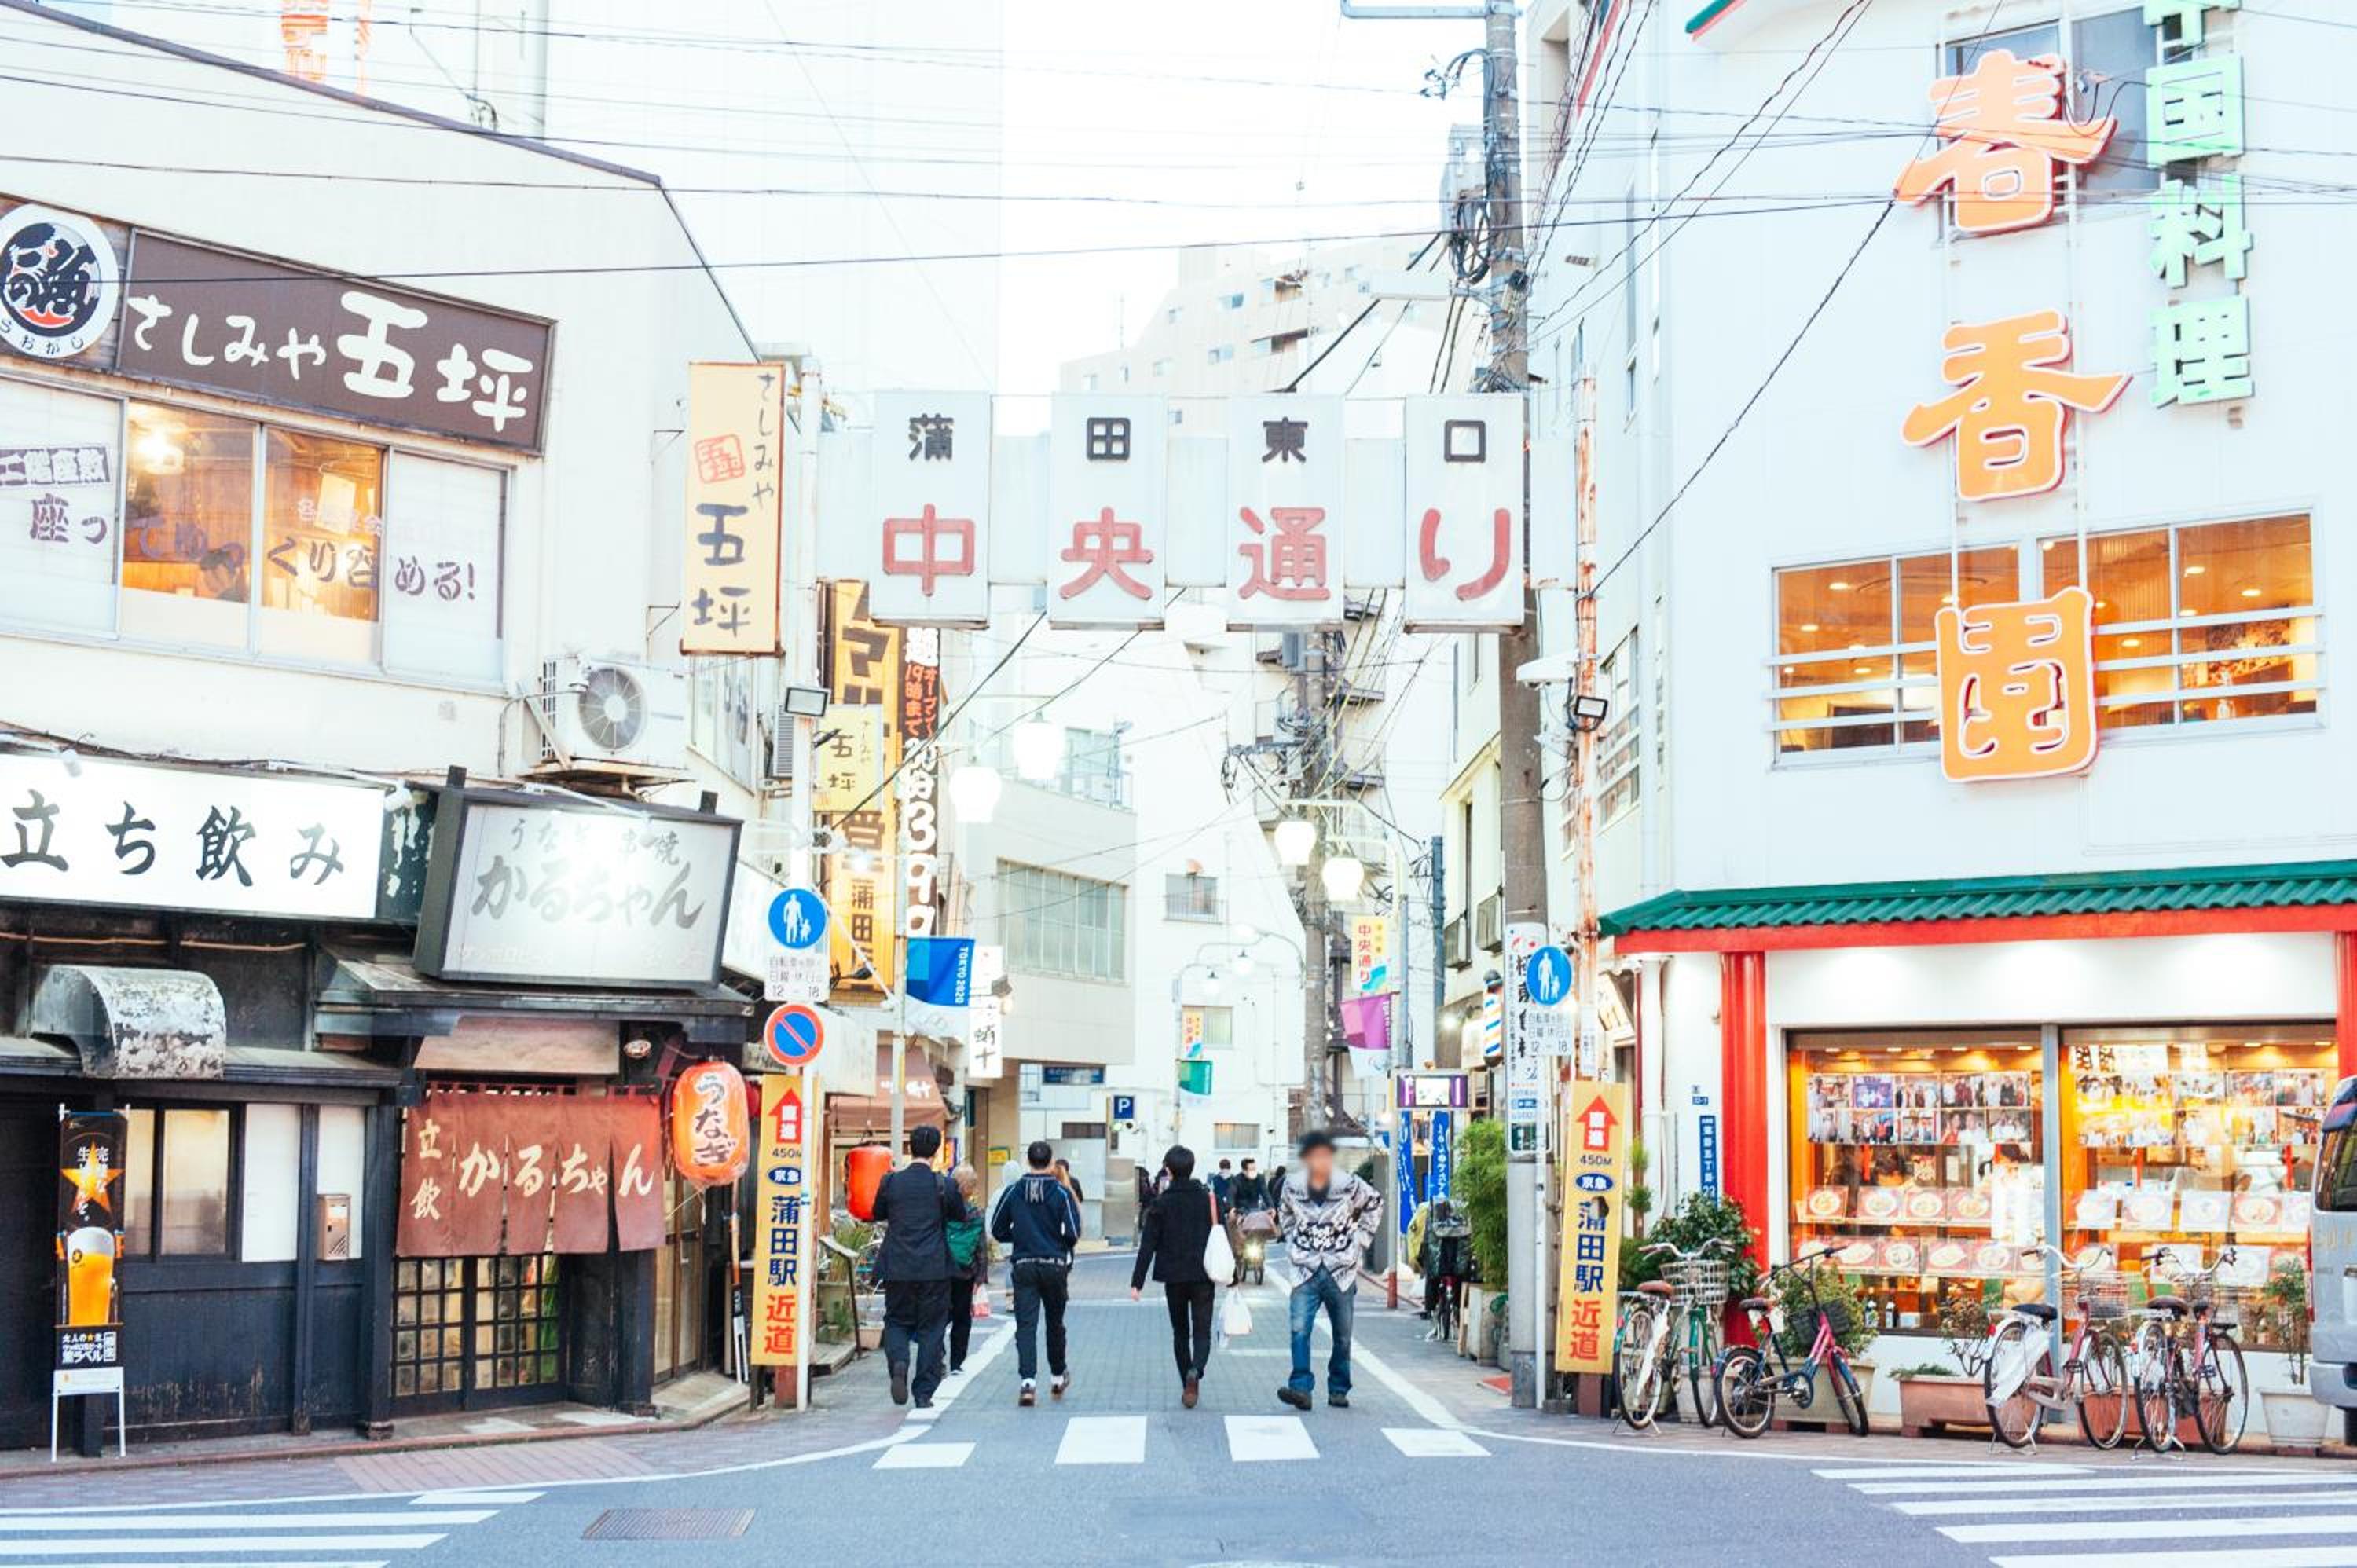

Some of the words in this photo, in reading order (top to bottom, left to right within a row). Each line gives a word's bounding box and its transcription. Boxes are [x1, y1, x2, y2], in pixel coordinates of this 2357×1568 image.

[752, 374, 775, 508] さしみや
[691, 503, 751, 638] 五坪
[882, 504, 1511, 601] 中央通り
[827, 734, 856, 793] 五坪
[1, 789, 345, 888] 立ち飲み
[472, 855, 705, 929] かるちゃん
[955, 980, 966, 1005] 2020
[957, 947, 969, 979] TOKYO
[694, 1074, 737, 1167] うなぎ
[1118, 1098, 1131, 1113] P
[410, 1118, 442, 1220] 立飲
[458, 1141, 654, 1198] かるちゃん
[775, 1170, 799, 1182] 京急
[1582, 1176, 1607, 1189] 京急
[767, 1195, 800, 1287] 蒲田駅
[764, 1294, 796, 1355] 近道
[1570, 1299, 1602, 1361] 近道
